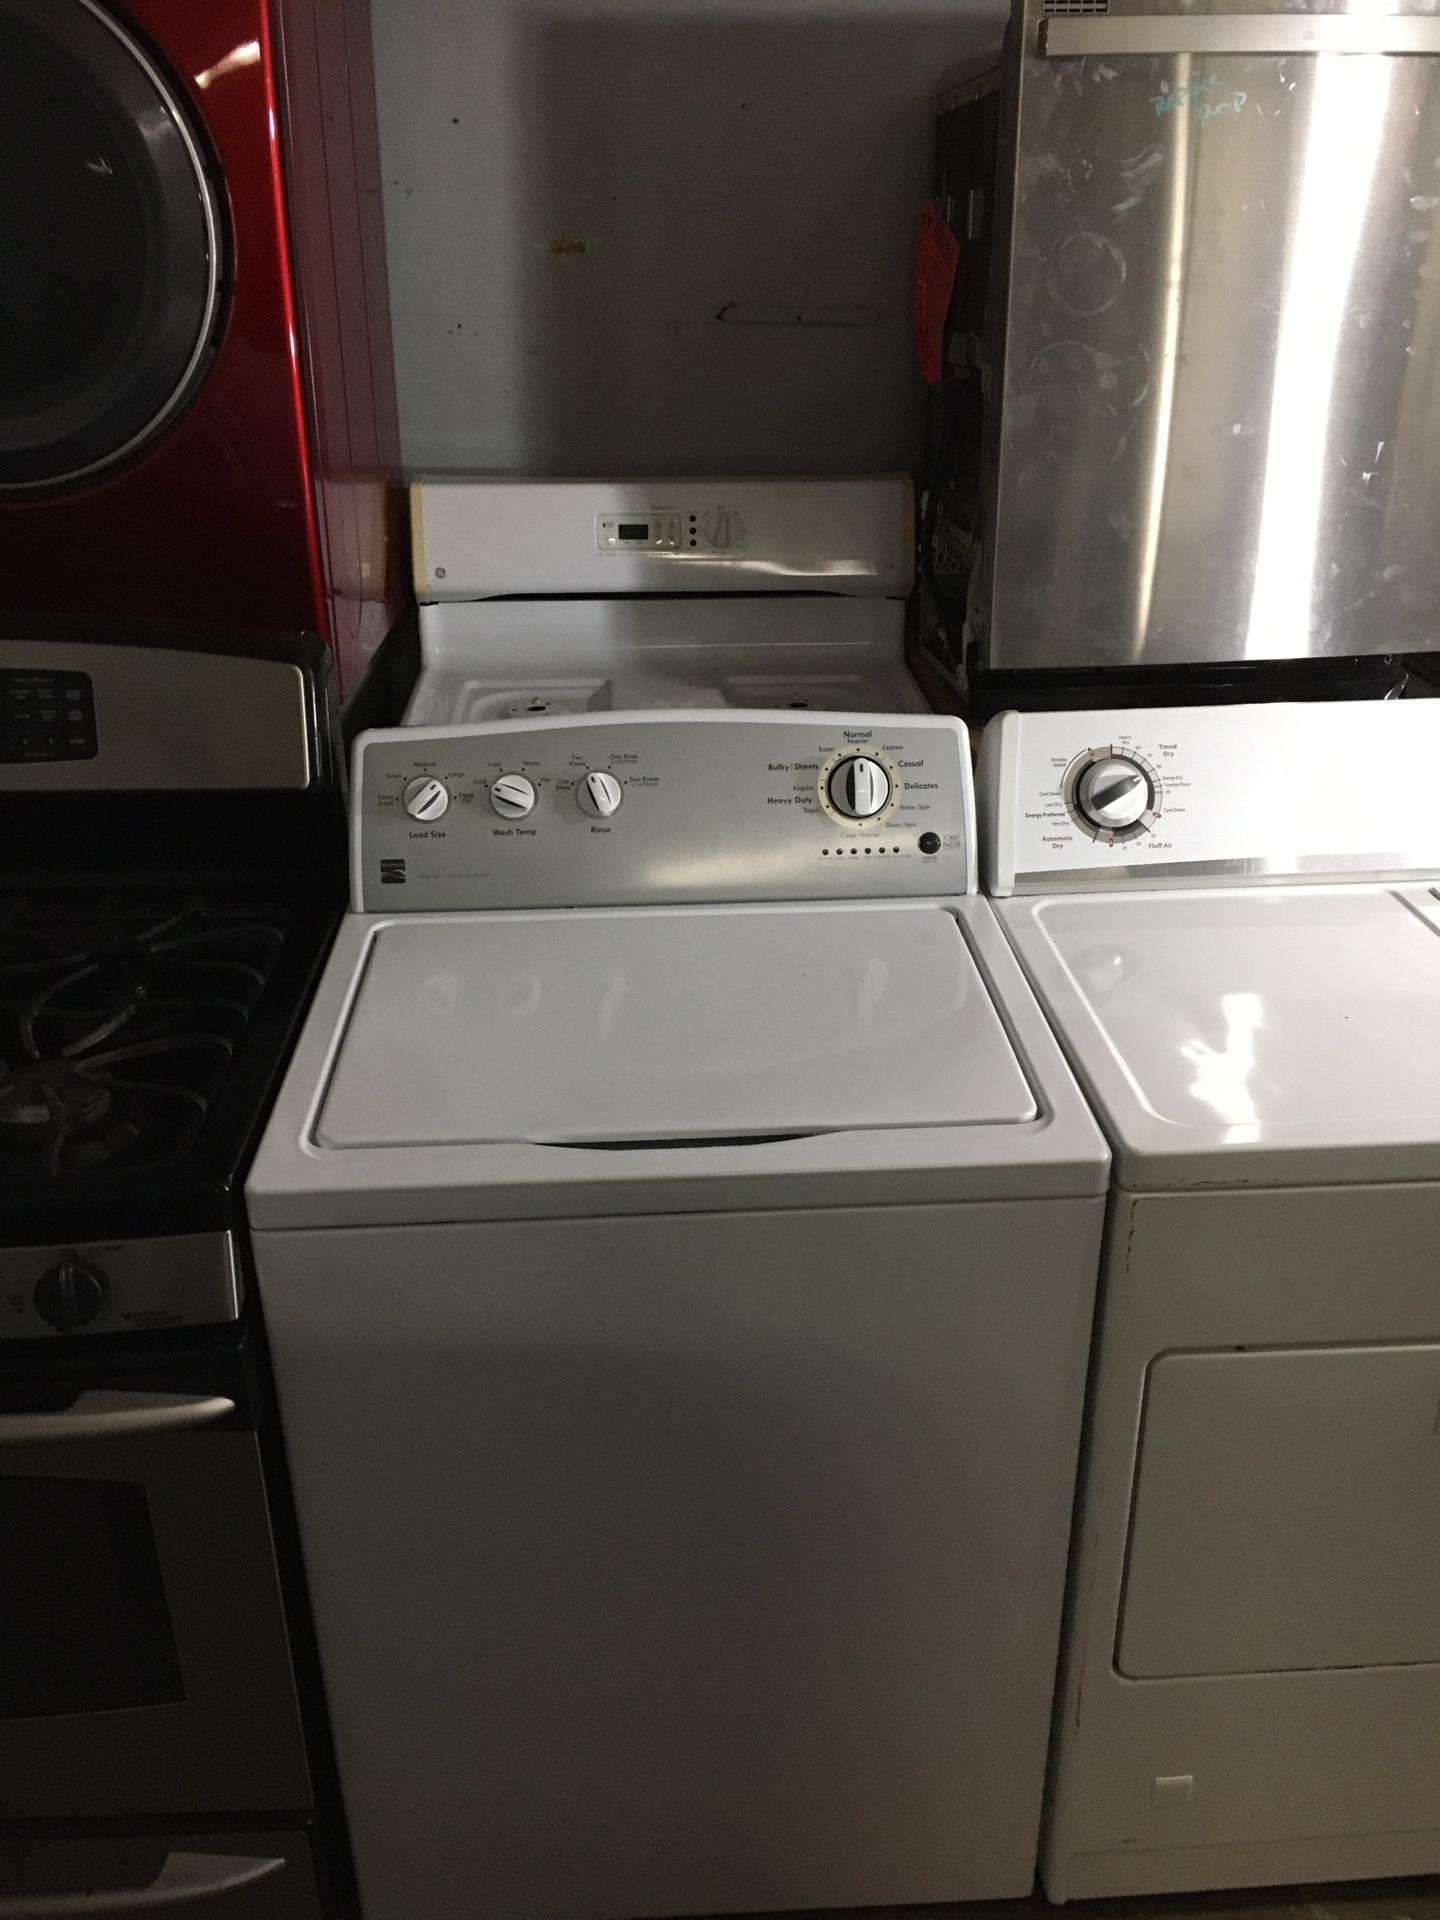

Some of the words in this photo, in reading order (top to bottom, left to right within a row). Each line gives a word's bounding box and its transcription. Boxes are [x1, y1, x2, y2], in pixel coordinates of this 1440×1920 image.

[768, 763, 790, 771] Bulky
[794, 762, 819, 770] Sheets
[904, 782, 938, 790] Delicates
[767, 797, 793, 805] Heavy
[795, 796, 812, 804] Duty
[1025, 811, 1042, 819] Energy
[409, 831, 428, 839] Load
[515, 828, 537, 837] Temp
